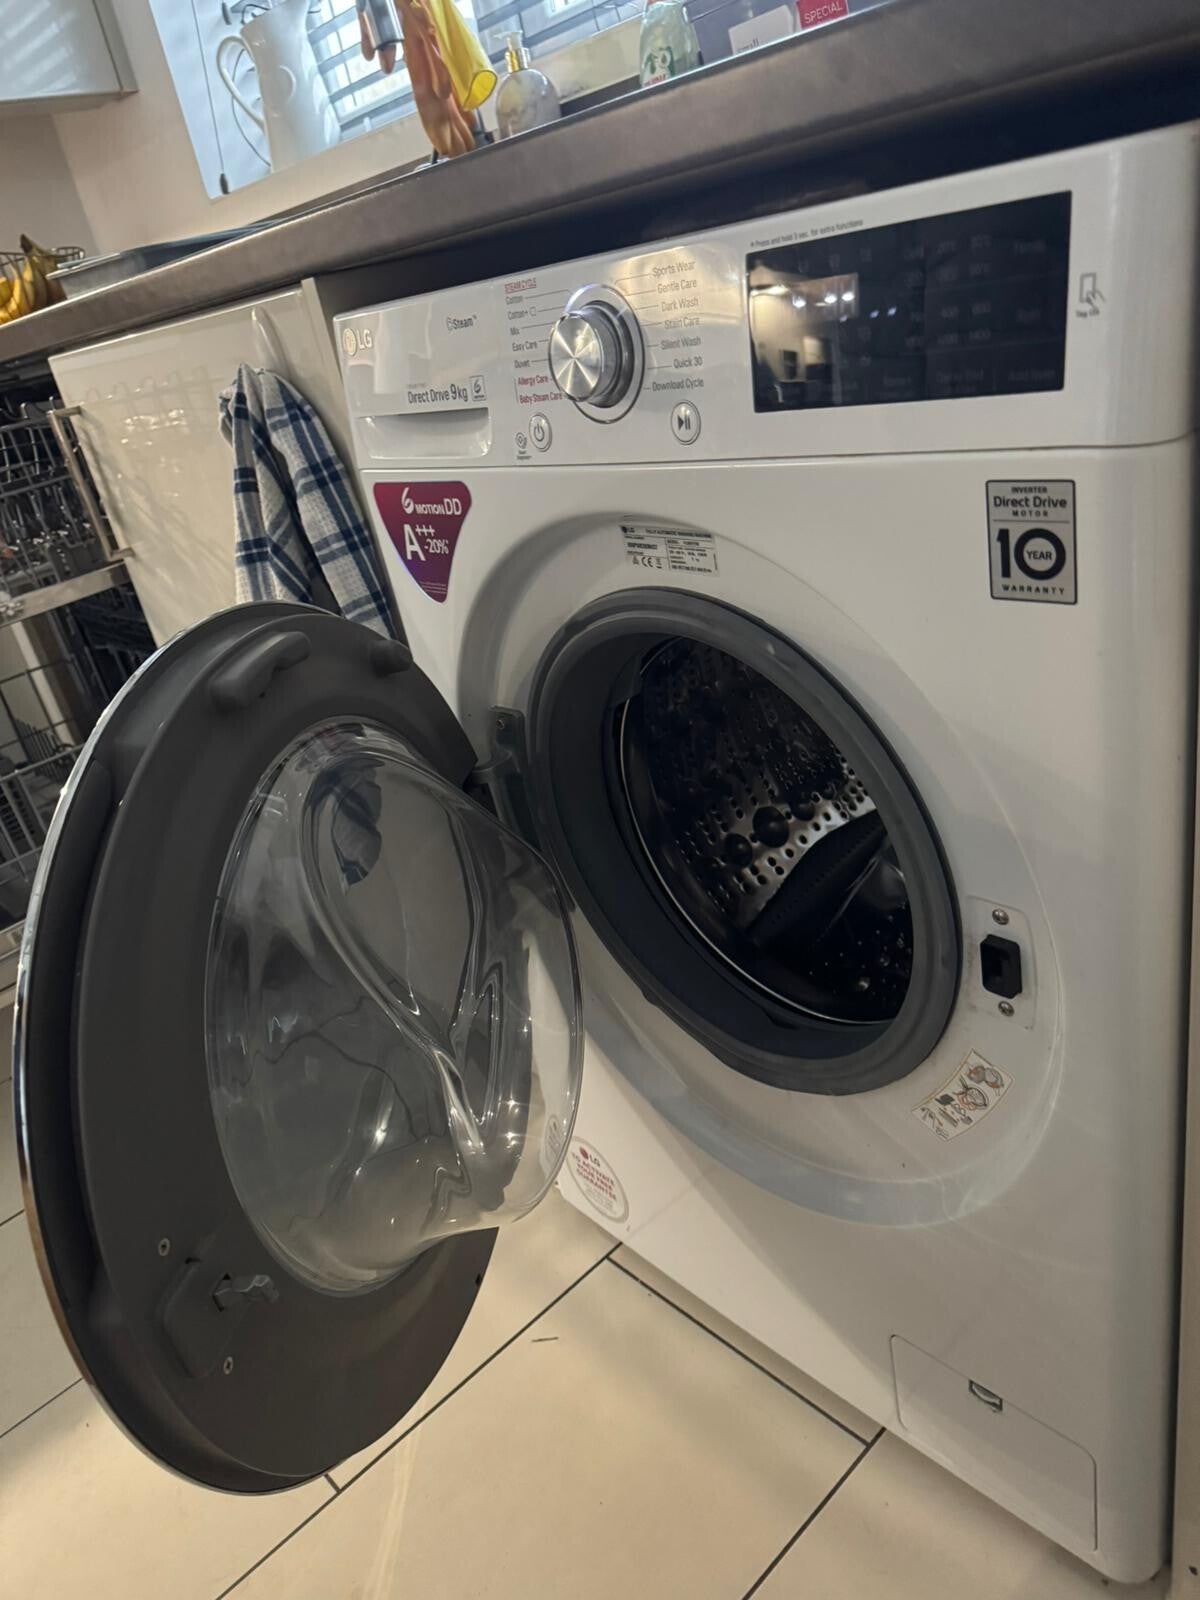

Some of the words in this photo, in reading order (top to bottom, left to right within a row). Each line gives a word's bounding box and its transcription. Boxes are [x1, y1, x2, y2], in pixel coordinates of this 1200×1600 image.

[803, 2, 843, 24] SPECIAL
[652, 264, 676, 278] Sports
[677, 261, 696, 274] Wear
[657, 280, 680, 294] Gentle
[680, 279, 697, 290] Care
[661, 301, 678, 312] Dark
[679, 296, 699, 309] Wash
[683, 316, 700, 328] Care
[525, 340, 538, 350] Care
[661, 338, 680, 350] Silent
[681, 335, 702, 347] Wash
[673, 357, 692, 369] Quick
[693, 355, 703, 367] 30
[517, 377, 535, 387] Allergy
[535, 374, 549, 384] Care
[652, 380, 685, 392] Download
[685, 378, 704, 390] Cycle
[407, 388, 430, 404] Direct
[430, 388, 450, 403] Drive
[519, 394, 532, 405] Baby
[533, 393, 549, 403] Steam
[550, 391, 563, 401] Care
[1011, 486, 1048, 494] INVERTER
[993, 496, 1030, 508] Direct
[1032, 496, 1067, 509] Drive
[996, 527, 1067, 581] 10
[1026, 550, 1053, 560] YEAR
[1002, 584, 1065, 596] WARRANTY
